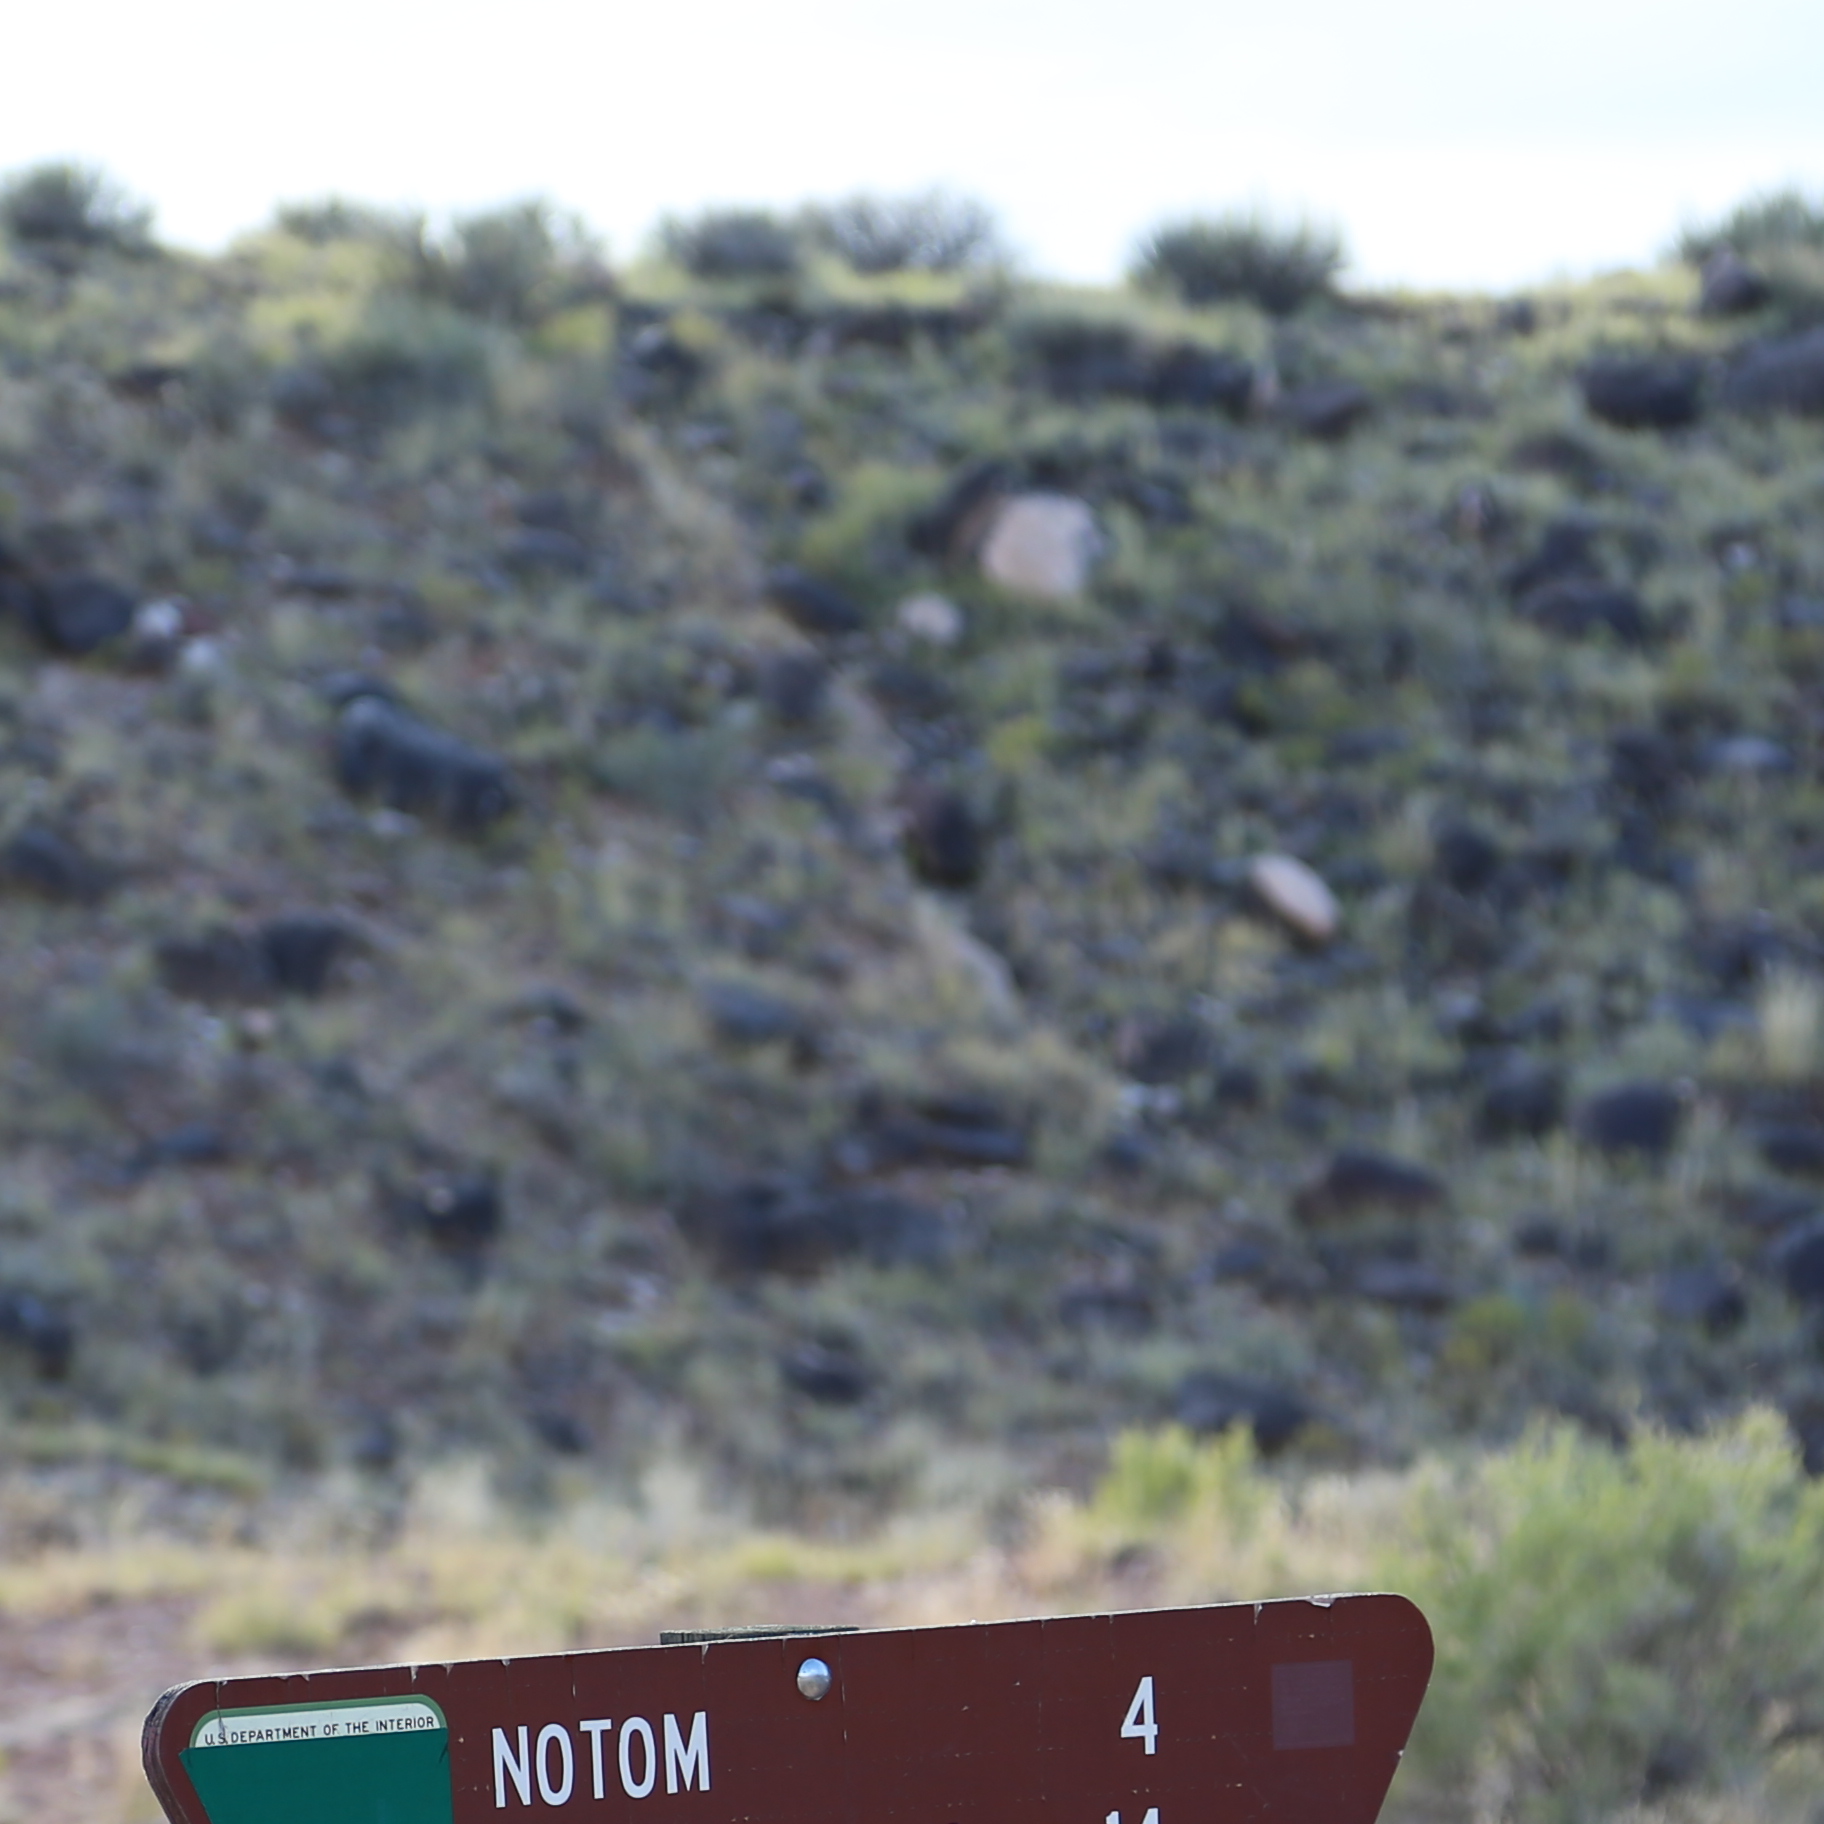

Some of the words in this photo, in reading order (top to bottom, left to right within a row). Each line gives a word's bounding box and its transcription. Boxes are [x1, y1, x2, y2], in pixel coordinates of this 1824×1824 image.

[231, 1725, 317, 1744] DEPARTMENT
[323, 1723, 339, 1736] OF
[345, 1720, 369, 1734] THE
[375, 1715, 435, 1731] INTERIOR
[491, 1711, 710, 1809] NOTOM
[1120, 1676, 1158, 1755] 4
